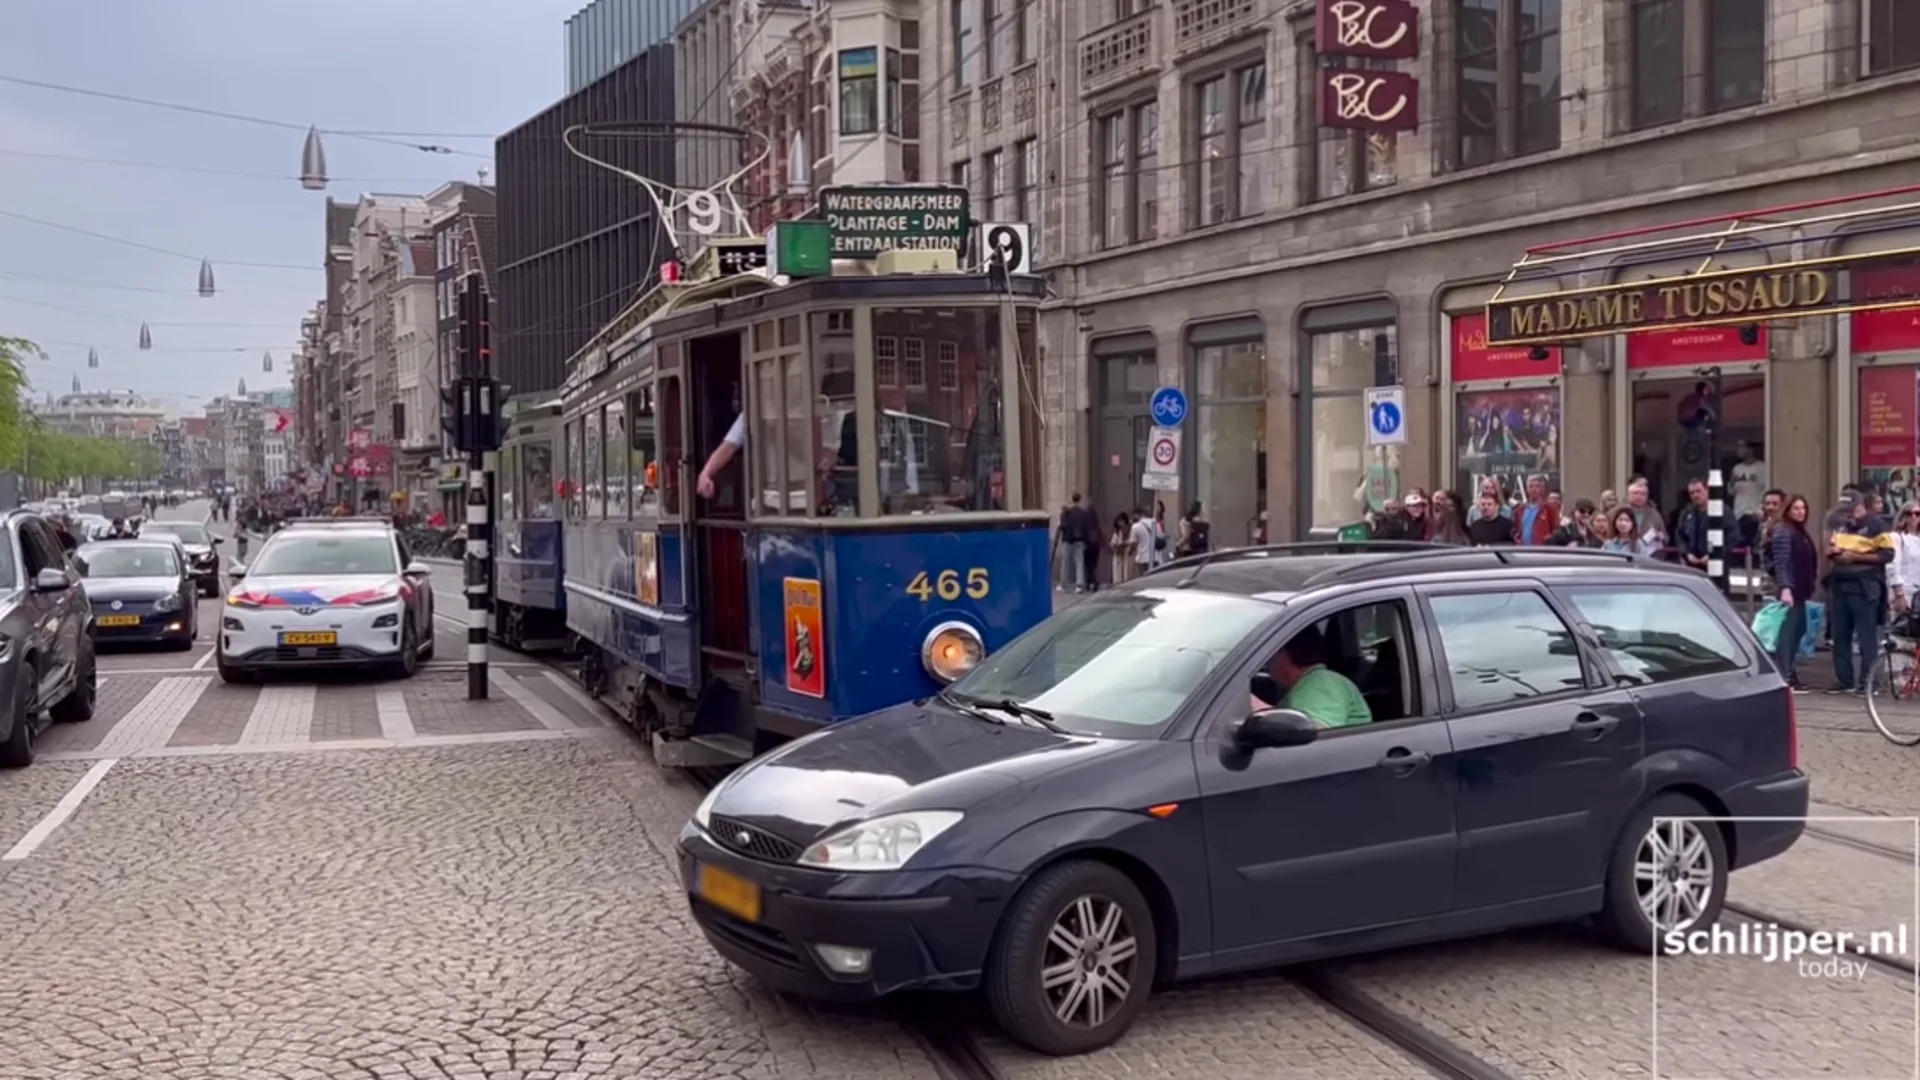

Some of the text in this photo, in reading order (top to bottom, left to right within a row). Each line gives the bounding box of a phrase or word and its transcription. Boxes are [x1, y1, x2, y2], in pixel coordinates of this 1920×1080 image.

[1329, 1, 1408, 49] P&C
[1329, 73, 1408, 122] P&C
[687, 190, 722, 235] 9
[825, 193, 962, 211] WATERGRAAFSMEER
[827, 213, 908, 231] PLANTAGE
[923, 213, 960, 231] DAM
[830, 234, 960, 252] ENTRAALSTATION
[988, 226, 1023, 273] 9
[1509, 269, 1829, 337] MADAME TUSSAUD
[1671, 334, 1725, 346] AMSTERDAM
[1158, 446, 1172, 456] 30
[905, 568, 990, 602] 465
